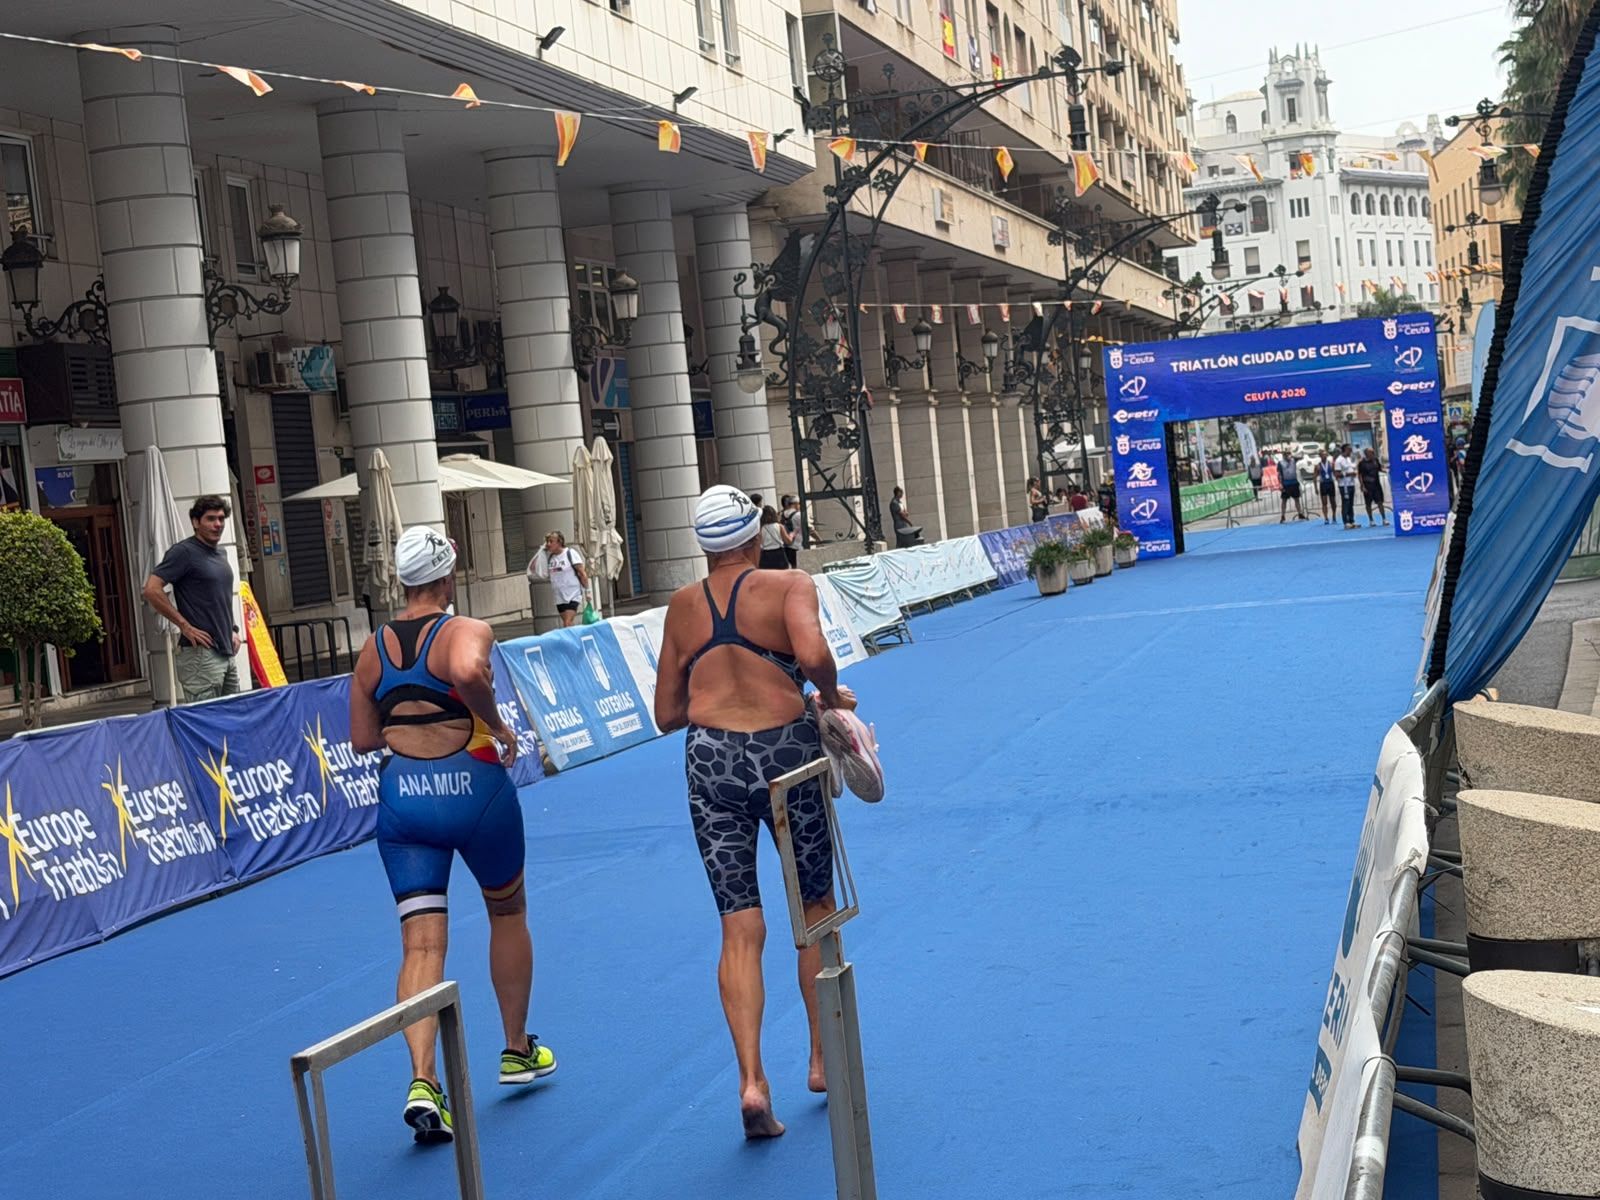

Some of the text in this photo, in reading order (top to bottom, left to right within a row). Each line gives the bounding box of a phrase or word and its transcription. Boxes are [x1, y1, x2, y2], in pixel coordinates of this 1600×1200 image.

[1404, 326, 1430, 335] Ceuta
[1129, 356, 1155, 365] Ceuta
[1170, 341, 1366, 372] TRIATLÓN CIUDAD DE CEUTA
[1244, 387, 1306, 402] CEUTA 2026
[1412, 415, 1438, 425] Ceuta
[1136, 442, 1161, 451] Ceuta
[1420, 517, 1446, 527] Ceuta
[1145, 542, 1171, 552] Ceuta
[594, 690, 634, 717] LOTERÍAS
[544, 704, 583, 732] OTERÍAS
[222, 758, 293, 802] Europe
[333, 769, 380, 809] Triath
[398, 771, 473, 797] ANA MUR
[236, 791, 321, 842] Triathlon
[9, 808, 97, 856] Europe
[30, 847, 124, 901] Triathlon
